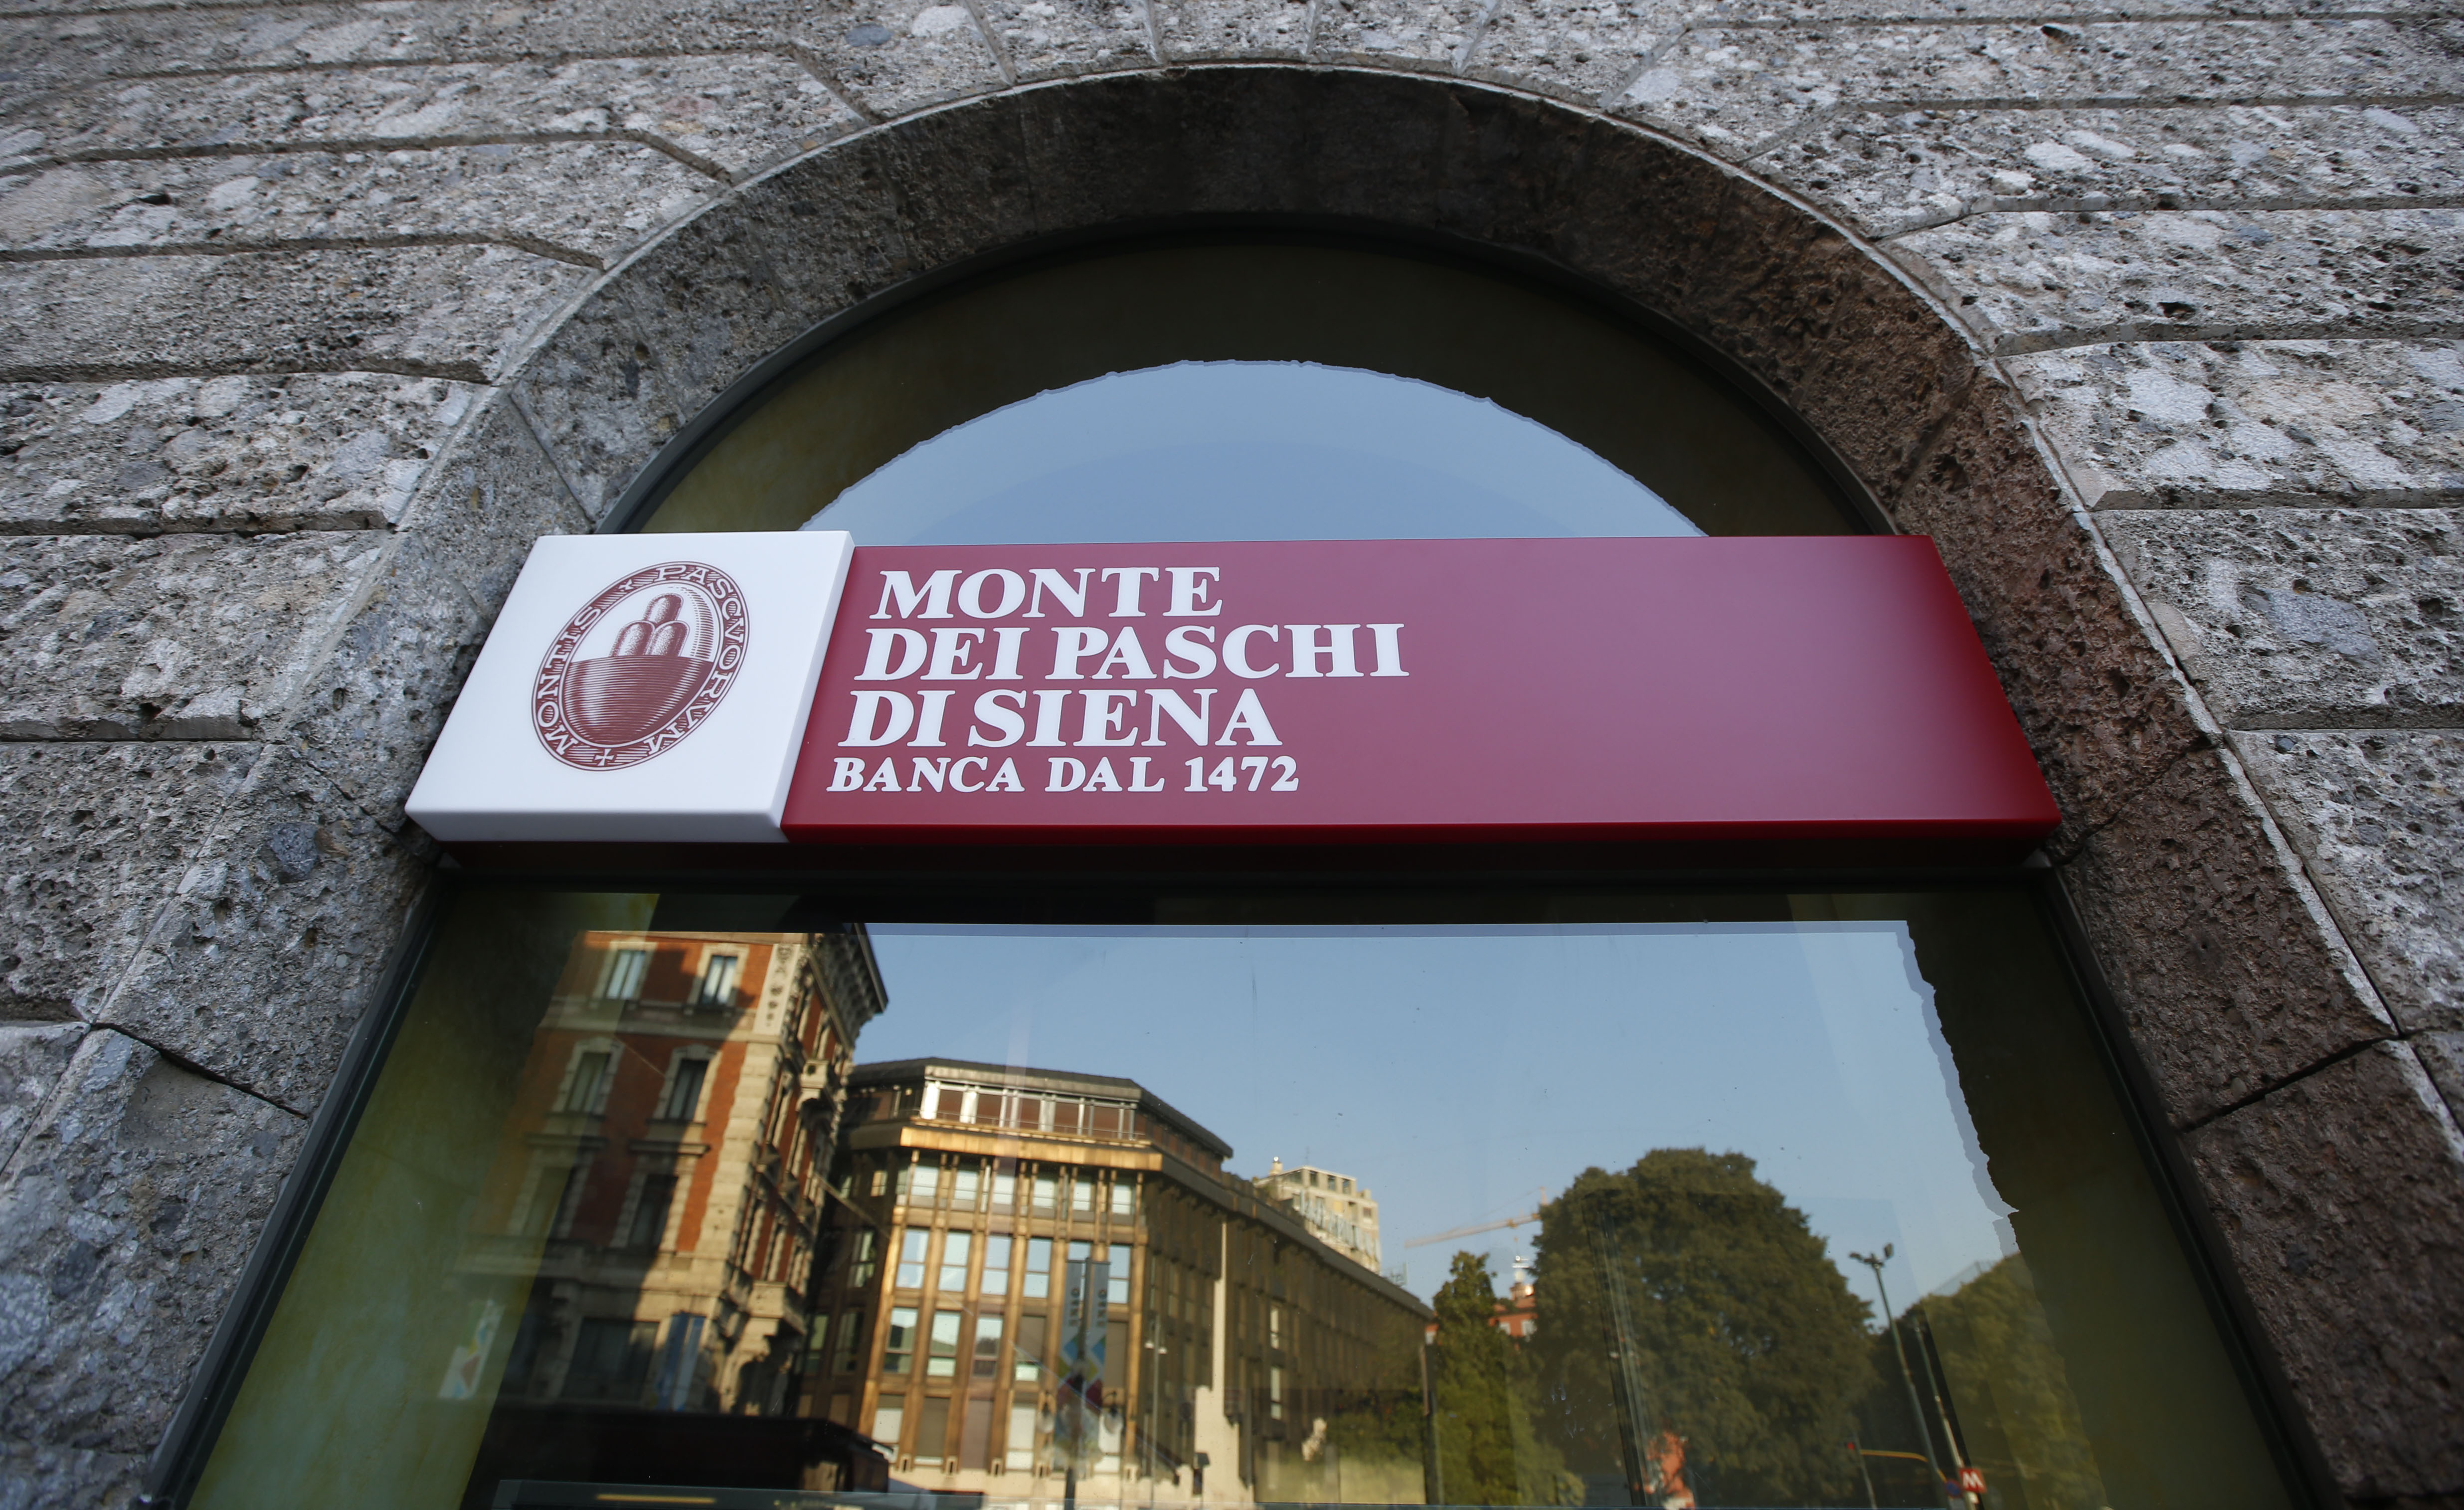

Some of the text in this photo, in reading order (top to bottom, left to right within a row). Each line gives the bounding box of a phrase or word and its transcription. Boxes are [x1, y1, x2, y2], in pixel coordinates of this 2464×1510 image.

[869, 566, 1223, 619] MONTE
[536, 605, 602, 755] MONTIS
[854, 623, 1410, 681] DEI PASCHI
[838, 688, 1283, 748] DI SIENA
[826, 755, 1299, 793] BANCA DAL 1472
